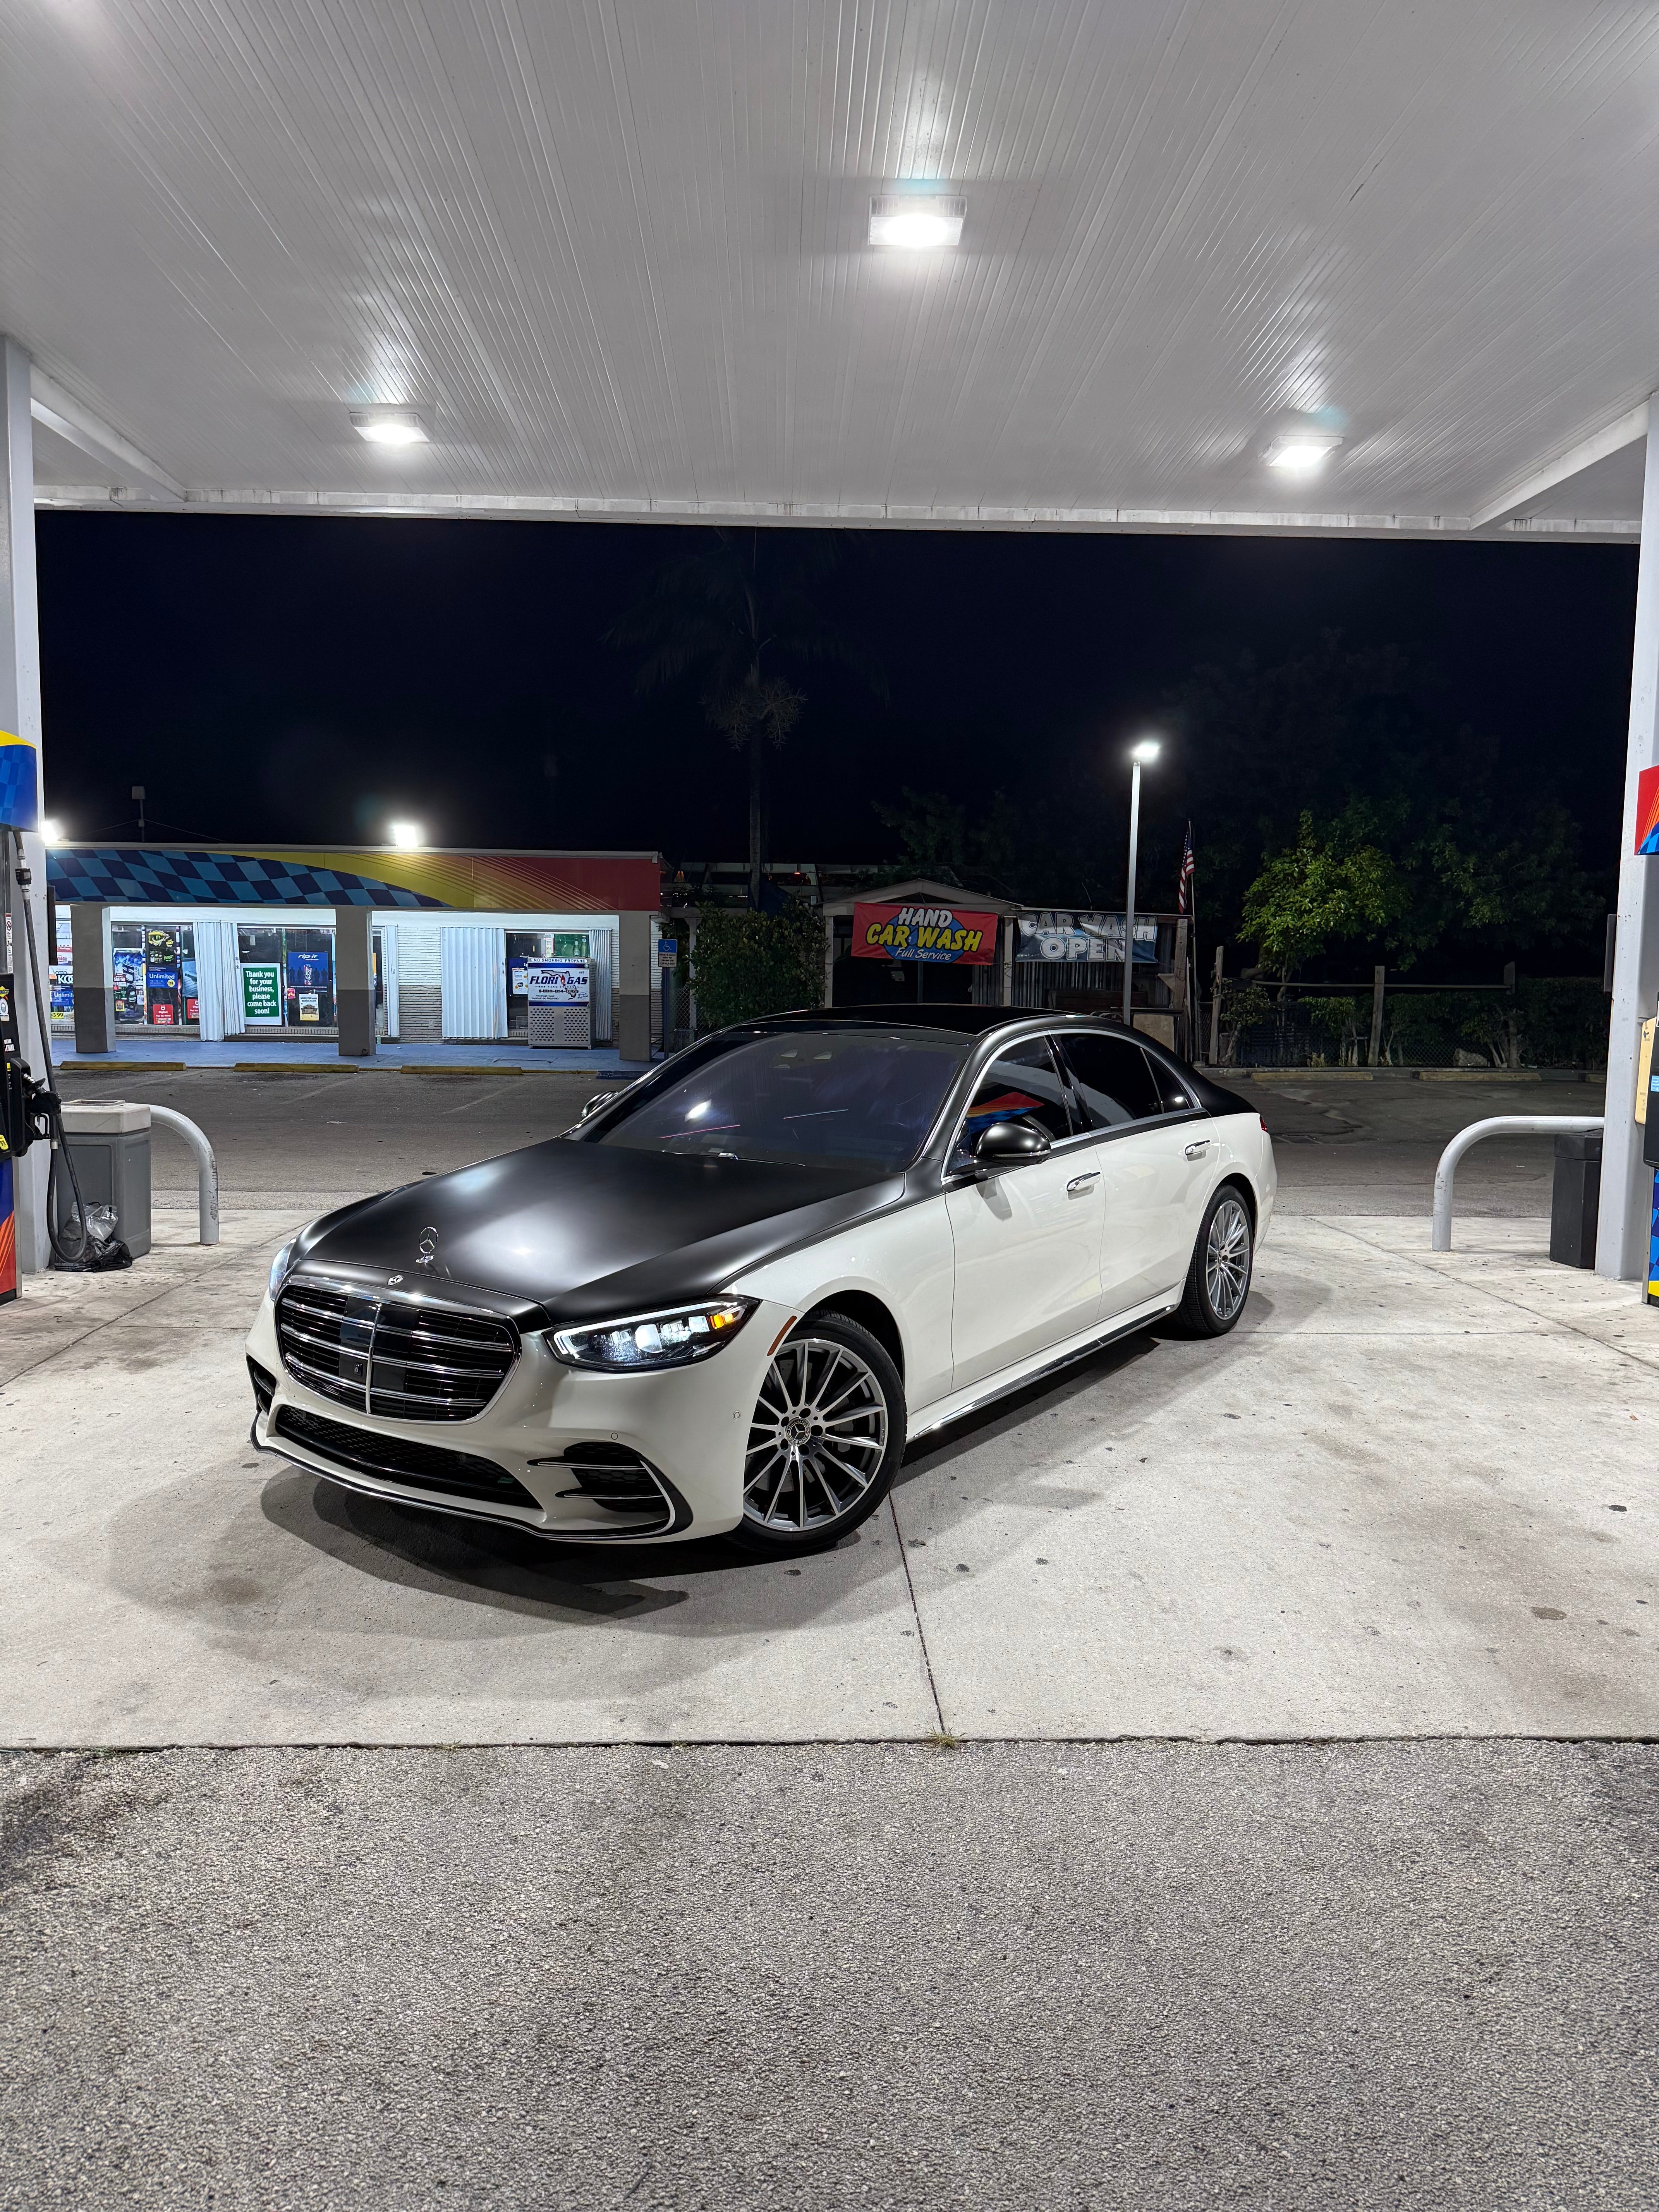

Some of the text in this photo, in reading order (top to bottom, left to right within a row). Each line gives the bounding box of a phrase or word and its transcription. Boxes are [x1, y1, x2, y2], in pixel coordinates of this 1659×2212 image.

[898, 907, 953, 927] HAND
[1018, 912, 1075, 937] CAR
[866, 923, 983, 952] CAR WASH
[895, 947, 951, 960] Full Service
[1040, 936, 1125, 962] OPEN
[529, 976, 588, 984] FLORI GAS
